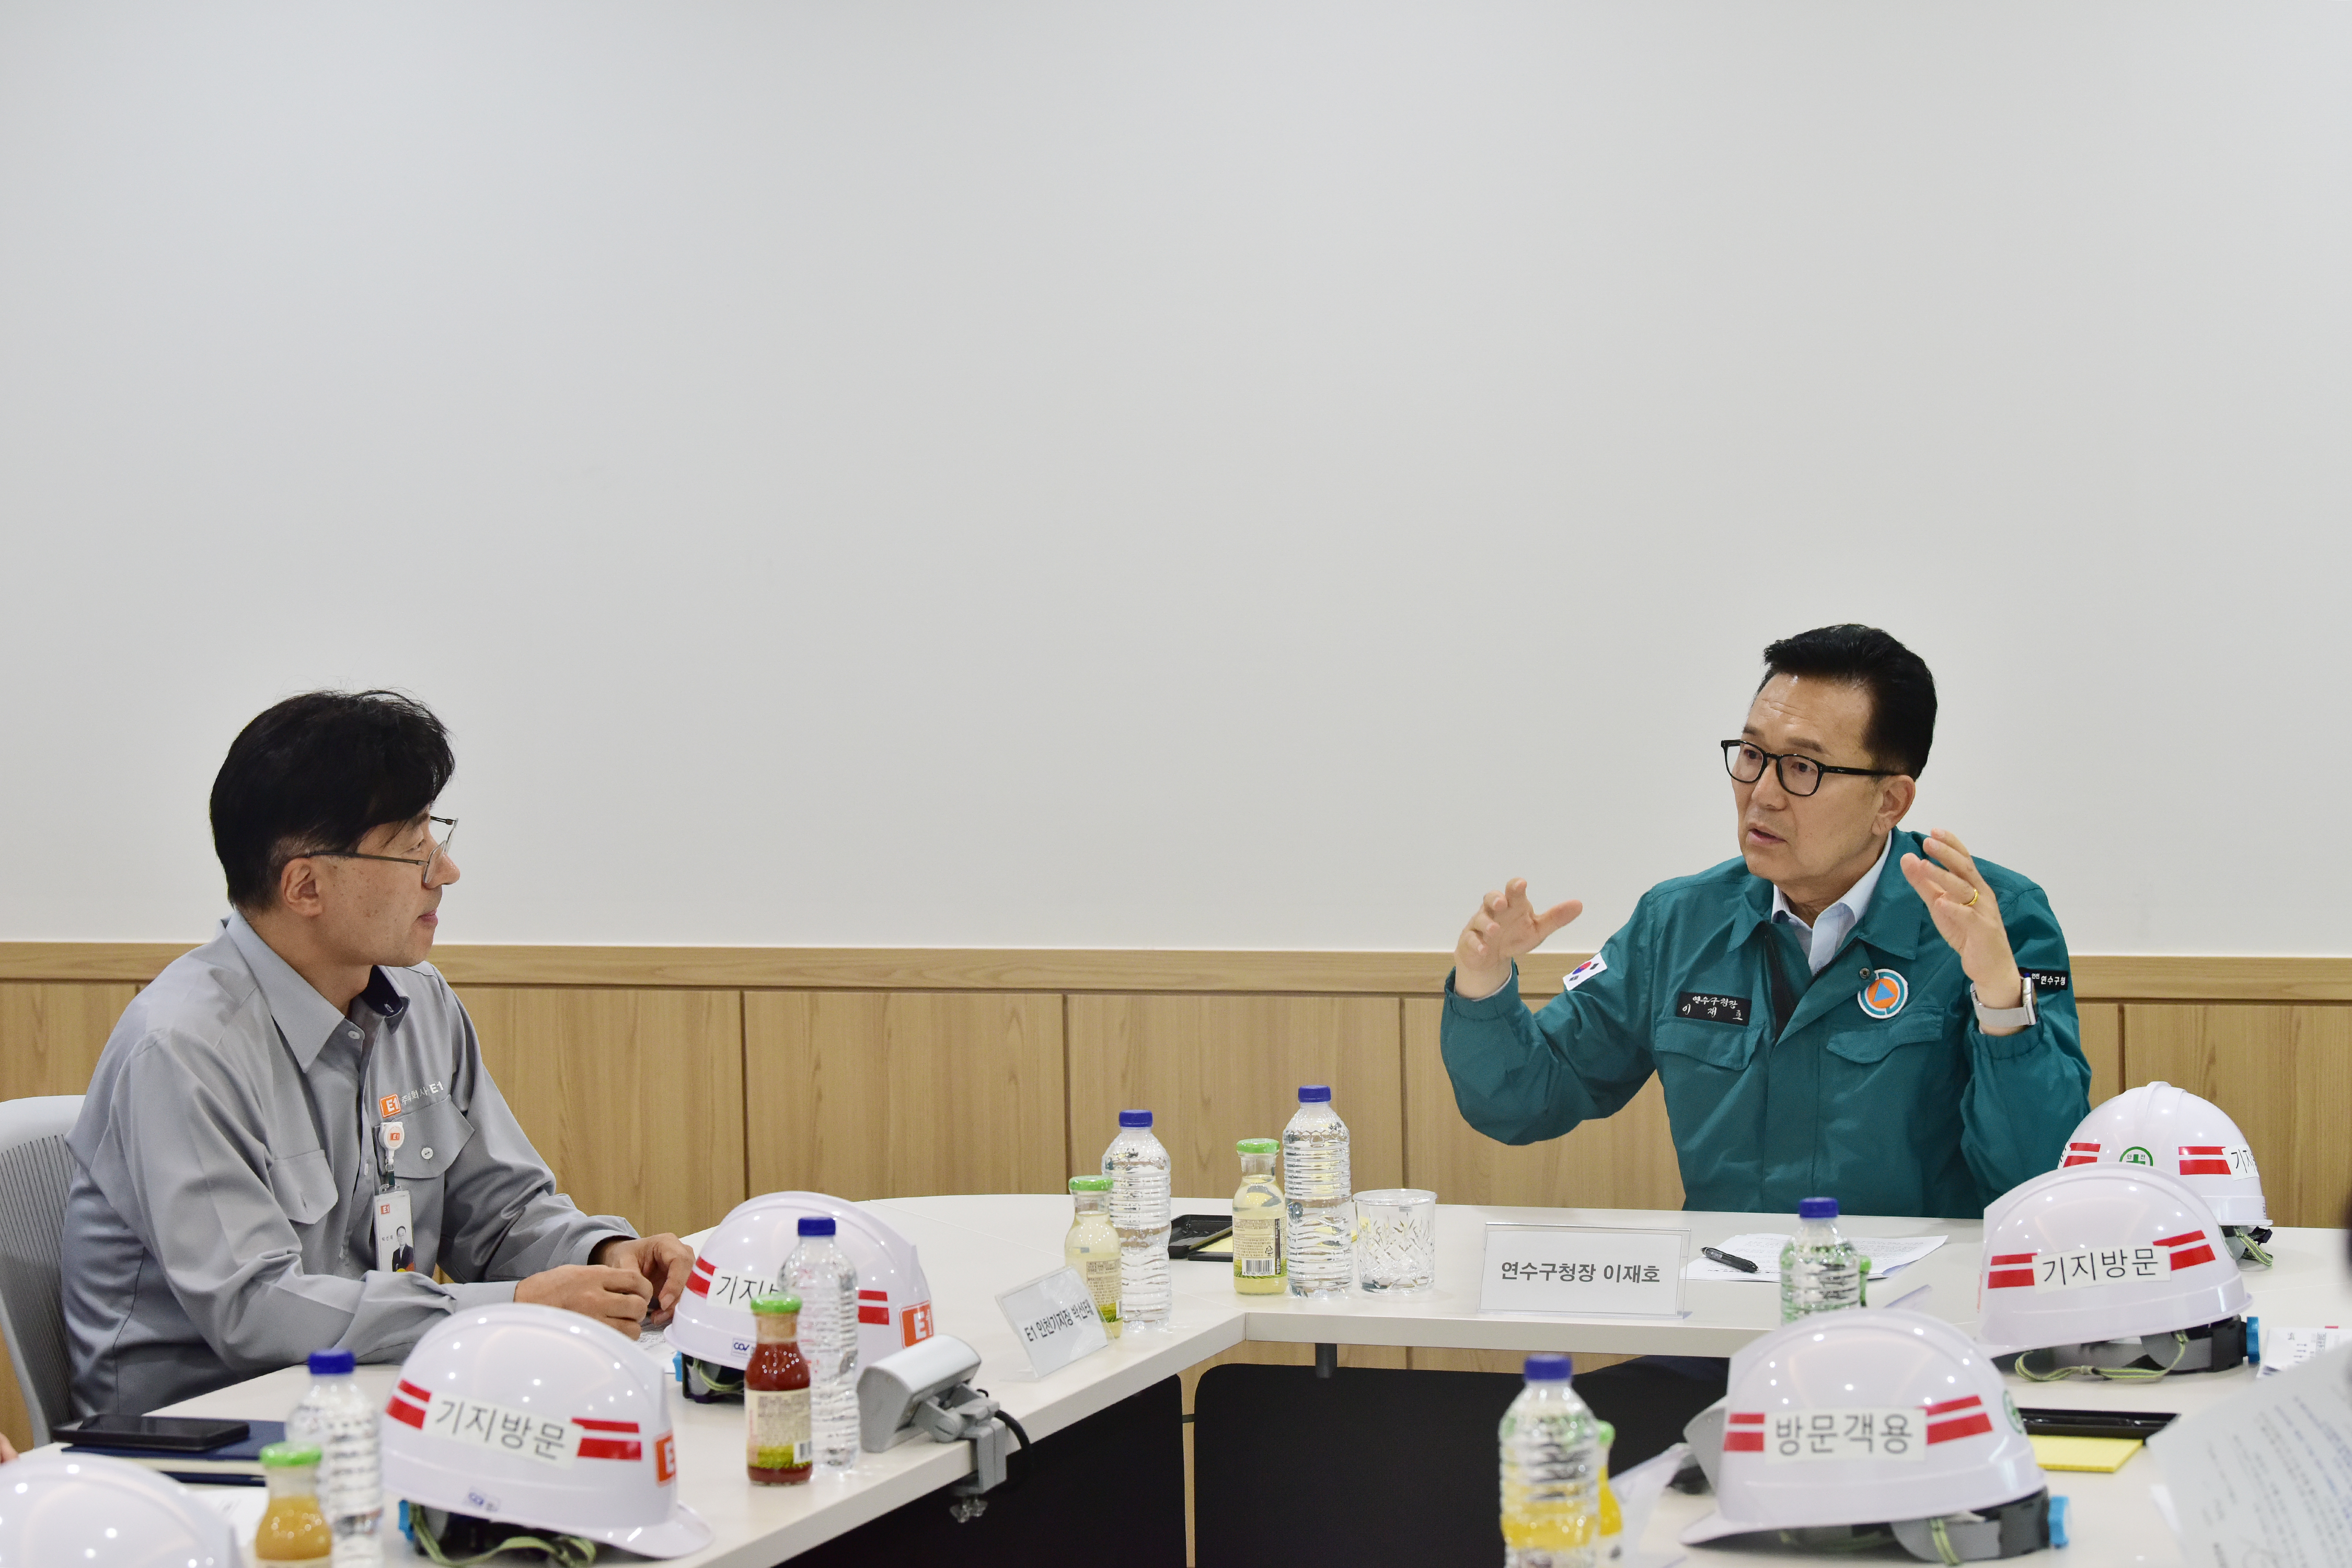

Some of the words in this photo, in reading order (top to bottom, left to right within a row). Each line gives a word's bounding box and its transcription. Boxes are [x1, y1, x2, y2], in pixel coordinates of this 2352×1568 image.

[2041, 975, 2066, 986] 연수구청
[1692, 996, 1738, 1009] 연수구청장
[429, 1081, 444, 1094] E1
[386, 1097, 399, 1112] E1
[2231, 1148, 2259, 1176] 기지
[1501, 1261, 1597, 1282] 연수구청장
[1603, 1264, 1661, 1283] 이재호
[2042, 1247, 2159, 1287] 기지방문
[716, 1276, 779, 1305] 기지
[913, 1308, 932, 1341] E1
[1024, 1325, 1037, 1342] E1
[1036, 1308, 1074, 1338] 인천기지장
[1070, 1298, 1094, 1321] 박선태
[435, 1399, 566, 1461] 기지방문
[1775, 1413, 1914, 1458] 방문객용
